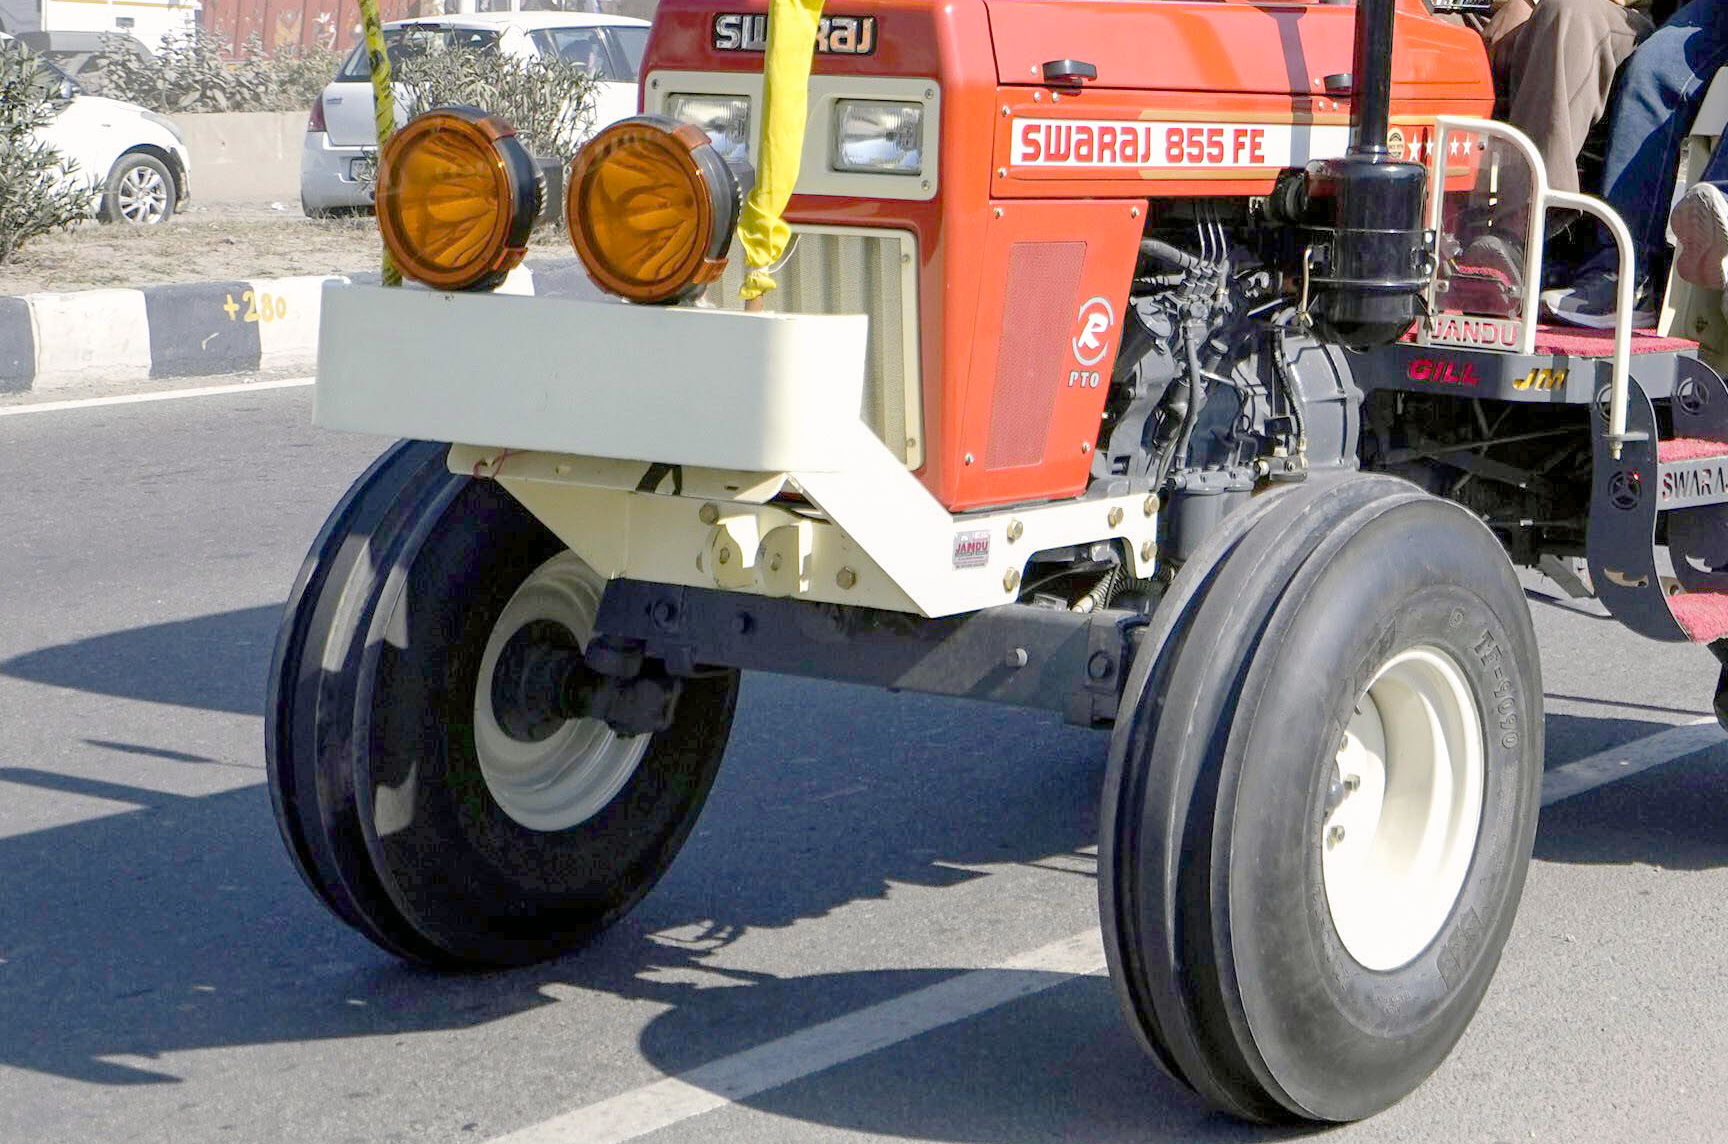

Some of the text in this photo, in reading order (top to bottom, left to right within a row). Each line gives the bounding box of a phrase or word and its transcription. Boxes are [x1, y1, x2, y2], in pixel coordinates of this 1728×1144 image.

[715, 13, 875, 54] SWRAJ
[1165, 126, 1225, 164] 855
[1232, 128, 1266, 165] FE
[223, 290, 287, 323] +280
[1431, 319, 1518, 347] JANDU
[1068, 370, 1100, 389] PTO
[1407, 357, 1570, 392] GILL JM
[955, 540, 989, 554] JANDU
